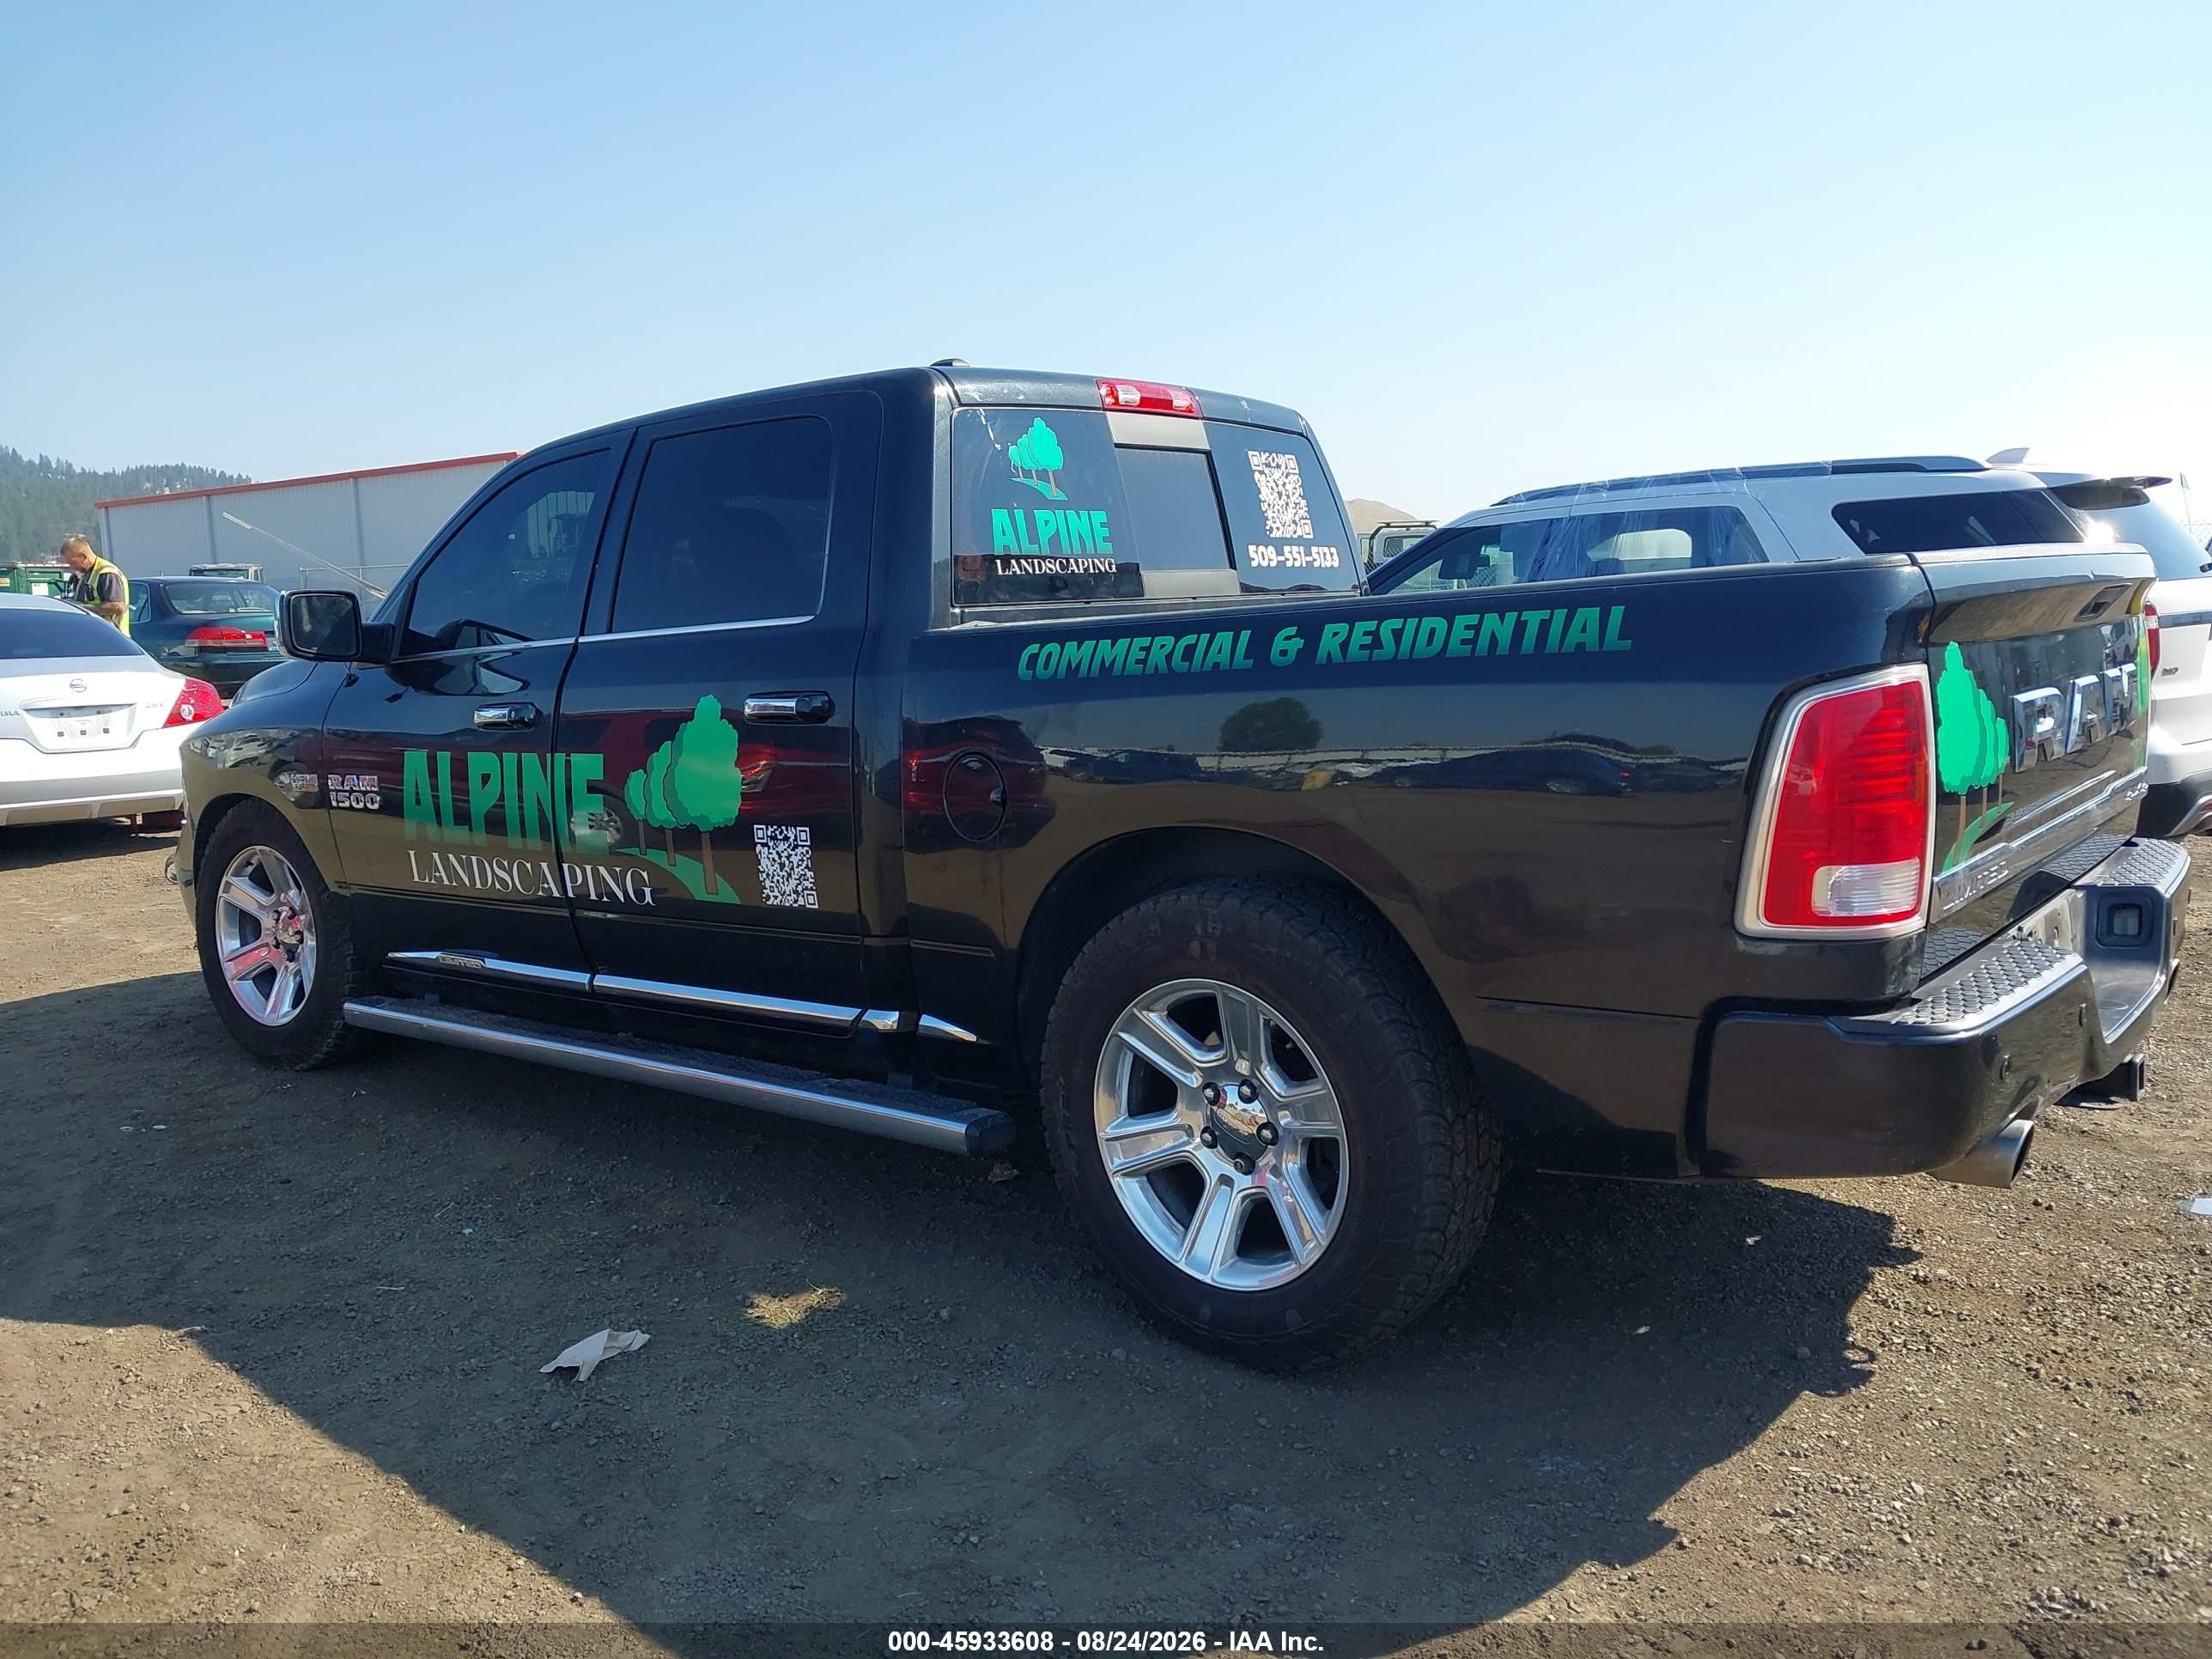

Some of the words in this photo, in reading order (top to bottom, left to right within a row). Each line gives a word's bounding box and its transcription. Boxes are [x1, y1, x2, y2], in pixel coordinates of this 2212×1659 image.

[991, 508, 1113, 555] ALPINE
[995, 558, 1116, 575] LANDSCAPING
[1248, 544, 1340, 568] 509-551-5133
[1018, 630, 1253, 680] COMMERCIAL
[1269, 626, 1304, 665] &
[1315, 605, 1632, 665] RESIDENTIAL
[327, 774, 379, 791] RAM
[329, 791, 380, 810] 1500
[404, 750, 604, 855] ALPINE
[407, 850, 656, 907] LANDSCAPING
